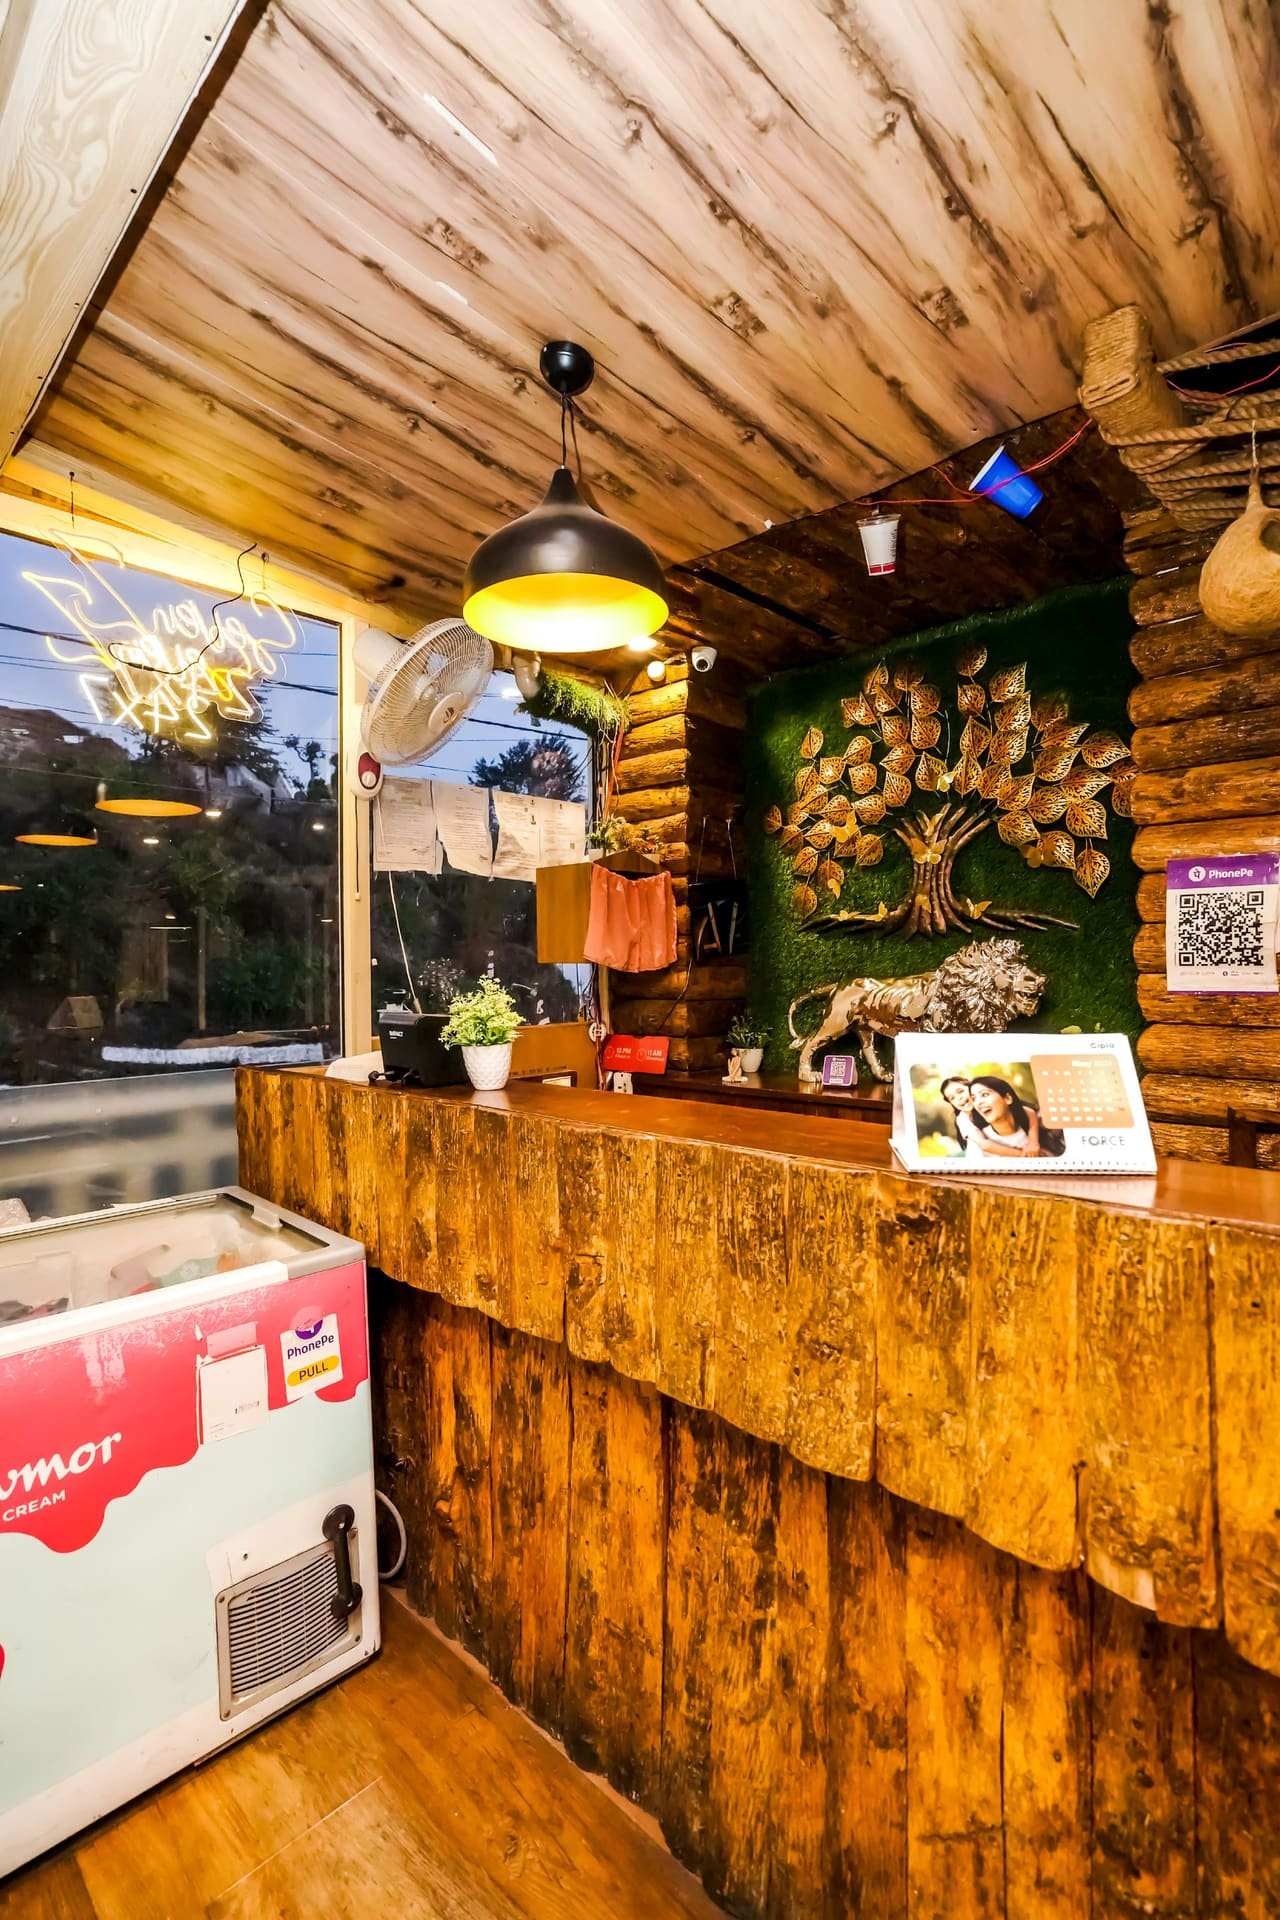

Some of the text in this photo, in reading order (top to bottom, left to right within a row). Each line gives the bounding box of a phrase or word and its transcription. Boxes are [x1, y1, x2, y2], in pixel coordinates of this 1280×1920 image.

[1208, 868, 1254, 879] PhonePe
[1081, 1135, 1126, 1147] FORCE
[286, 1332, 335, 1360] PhonePe
[298, 1361, 329, 1381] PULL
[2, 1489, 66, 1522] CREAM
